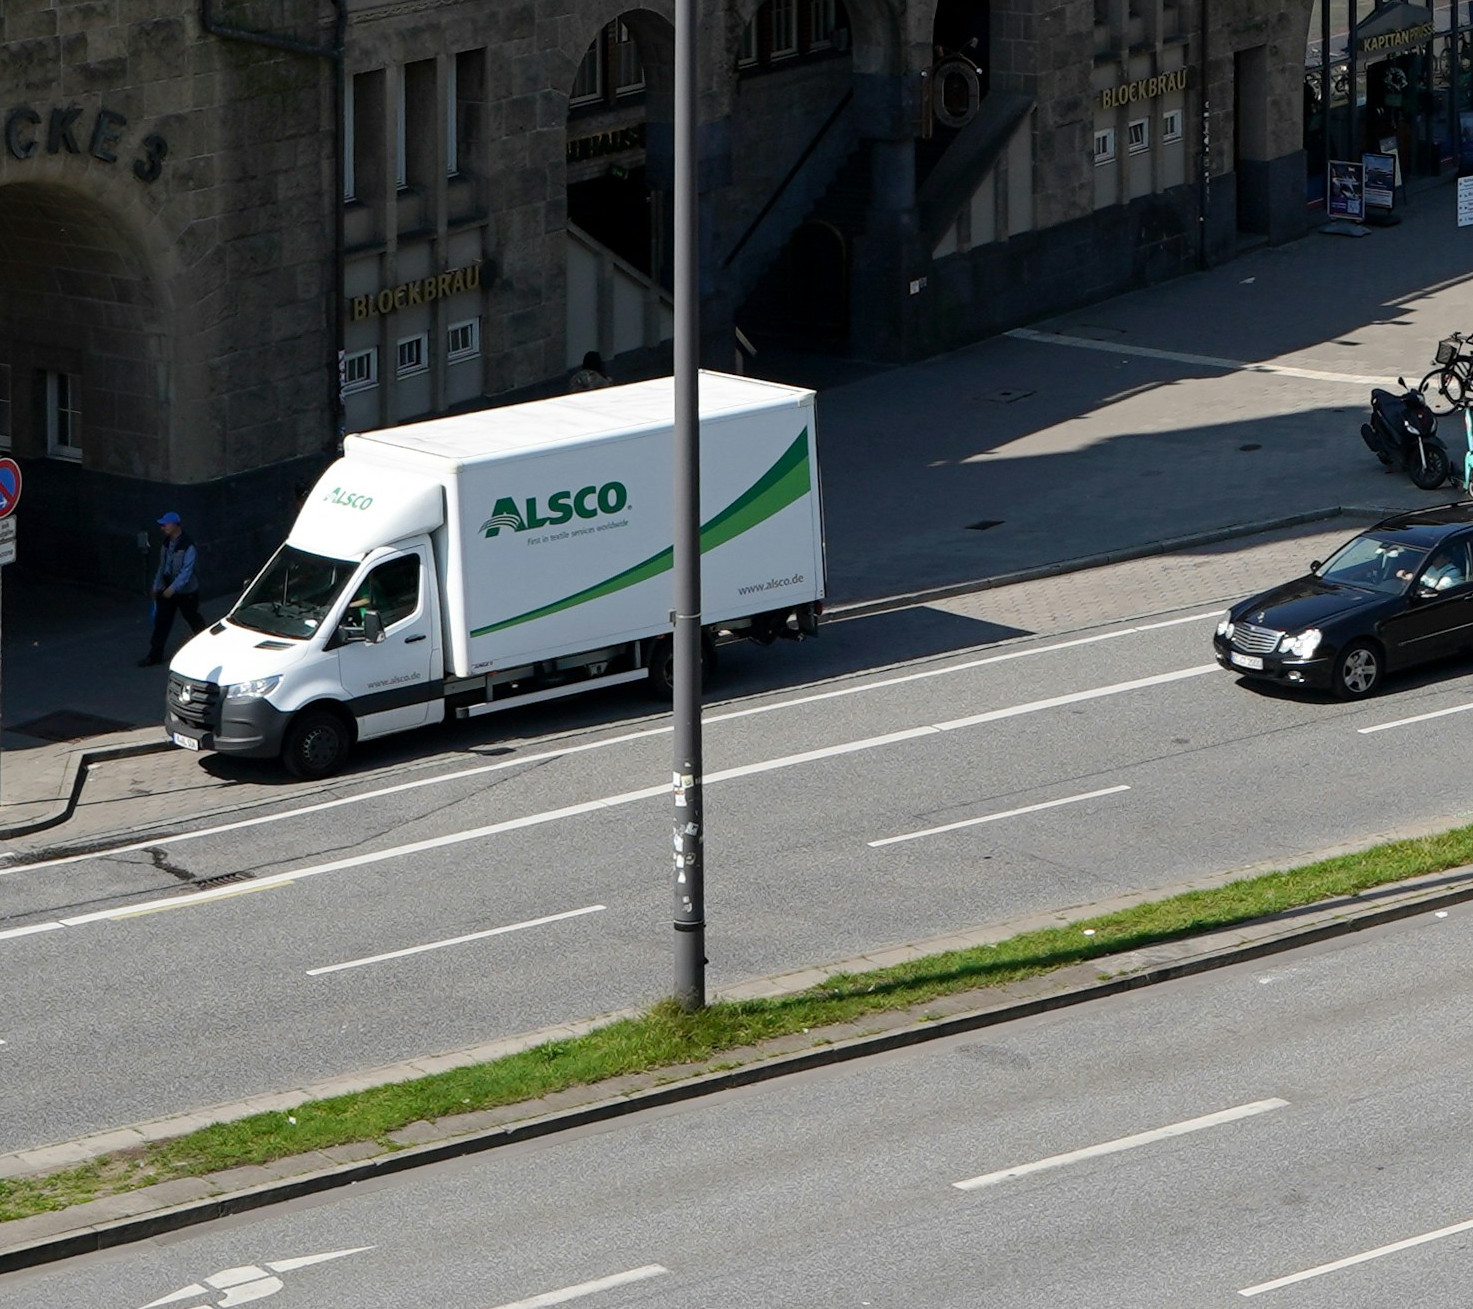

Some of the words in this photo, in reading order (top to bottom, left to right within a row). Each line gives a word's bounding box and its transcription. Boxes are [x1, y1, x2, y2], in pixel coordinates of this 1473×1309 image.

[133, 131, 169, 183] 3
[323, 487, 373, 510] ALSCO
[477, 481, 628, 538] ALSCO
[738, 573, 804, 596] www.alsco.de
[367, 671, 421, 689] www.alsco.de
